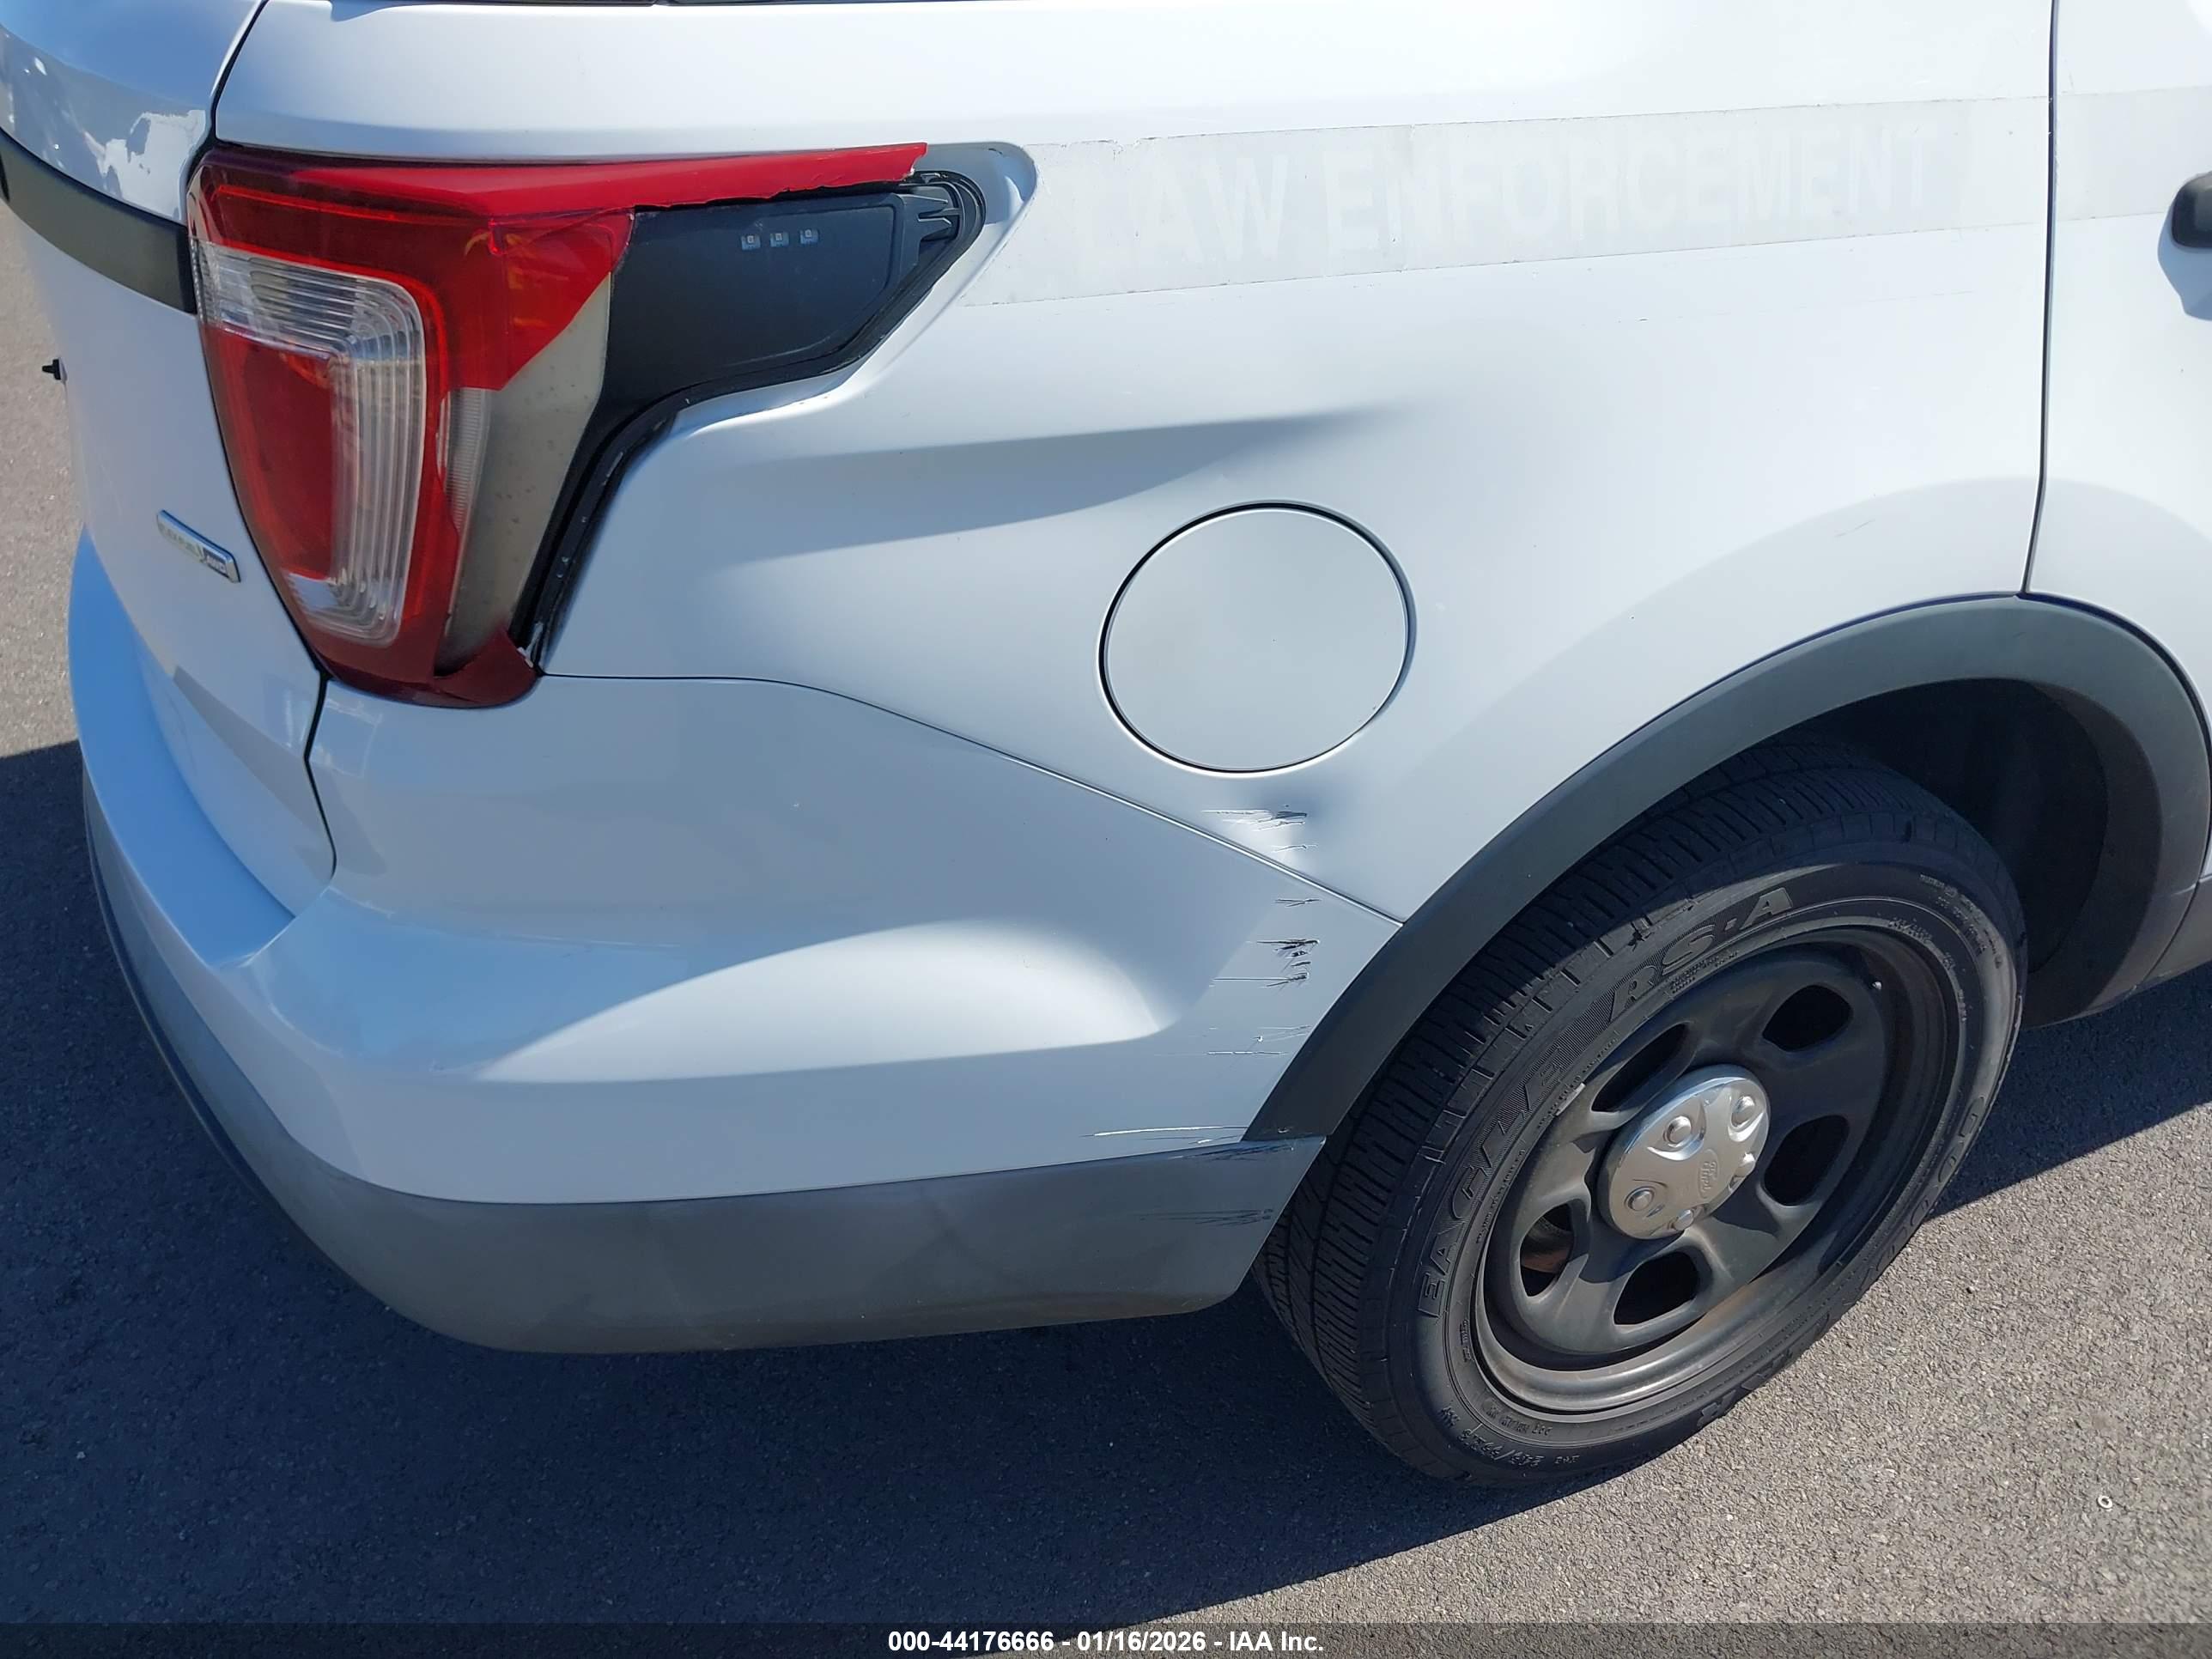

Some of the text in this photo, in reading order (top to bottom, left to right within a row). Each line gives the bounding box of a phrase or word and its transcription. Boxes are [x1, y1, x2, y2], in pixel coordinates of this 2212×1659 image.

[1073, 123, 1940, 273] LAW ENFORCEMENT
[1417, 1046, 1565, 1319] EAGLE
